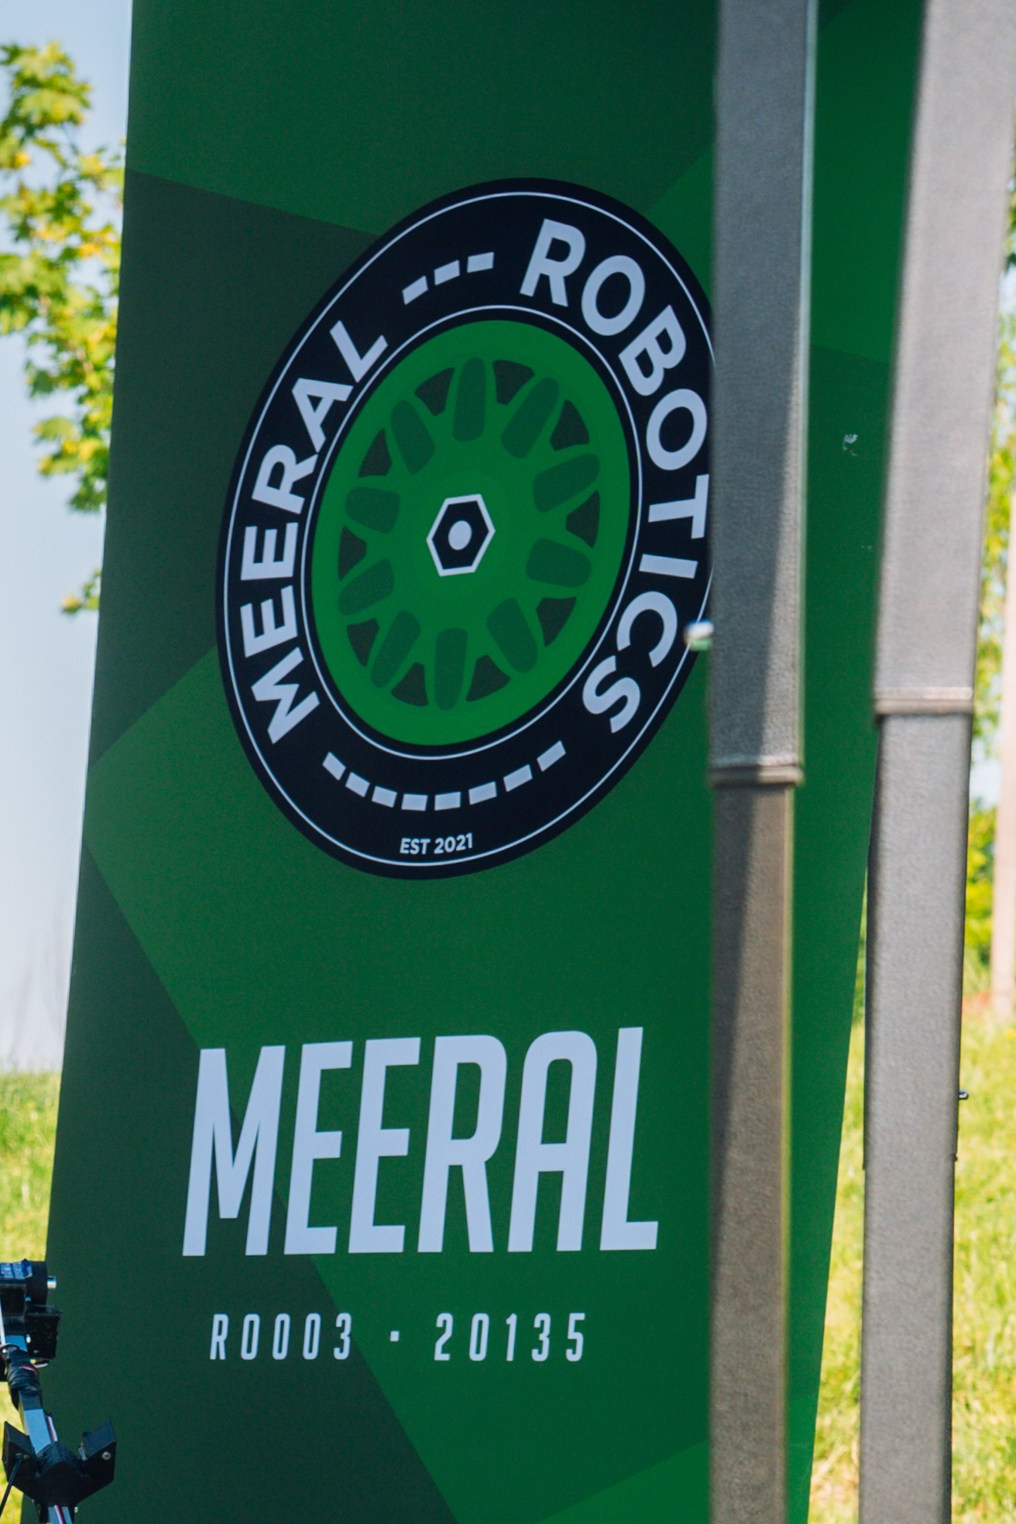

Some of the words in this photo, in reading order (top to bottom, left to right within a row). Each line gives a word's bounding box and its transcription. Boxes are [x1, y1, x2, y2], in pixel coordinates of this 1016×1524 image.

[241, 321, 388, 743] MEERAL
[520, 218, 710, 733] ROBOTICS
[400, 837, 431, 855] EST
[433, 832, 473, 855] 2021
[182, 1026, 659, 1257] MEERAL
[434, 1312, 586, 1362] 20135
